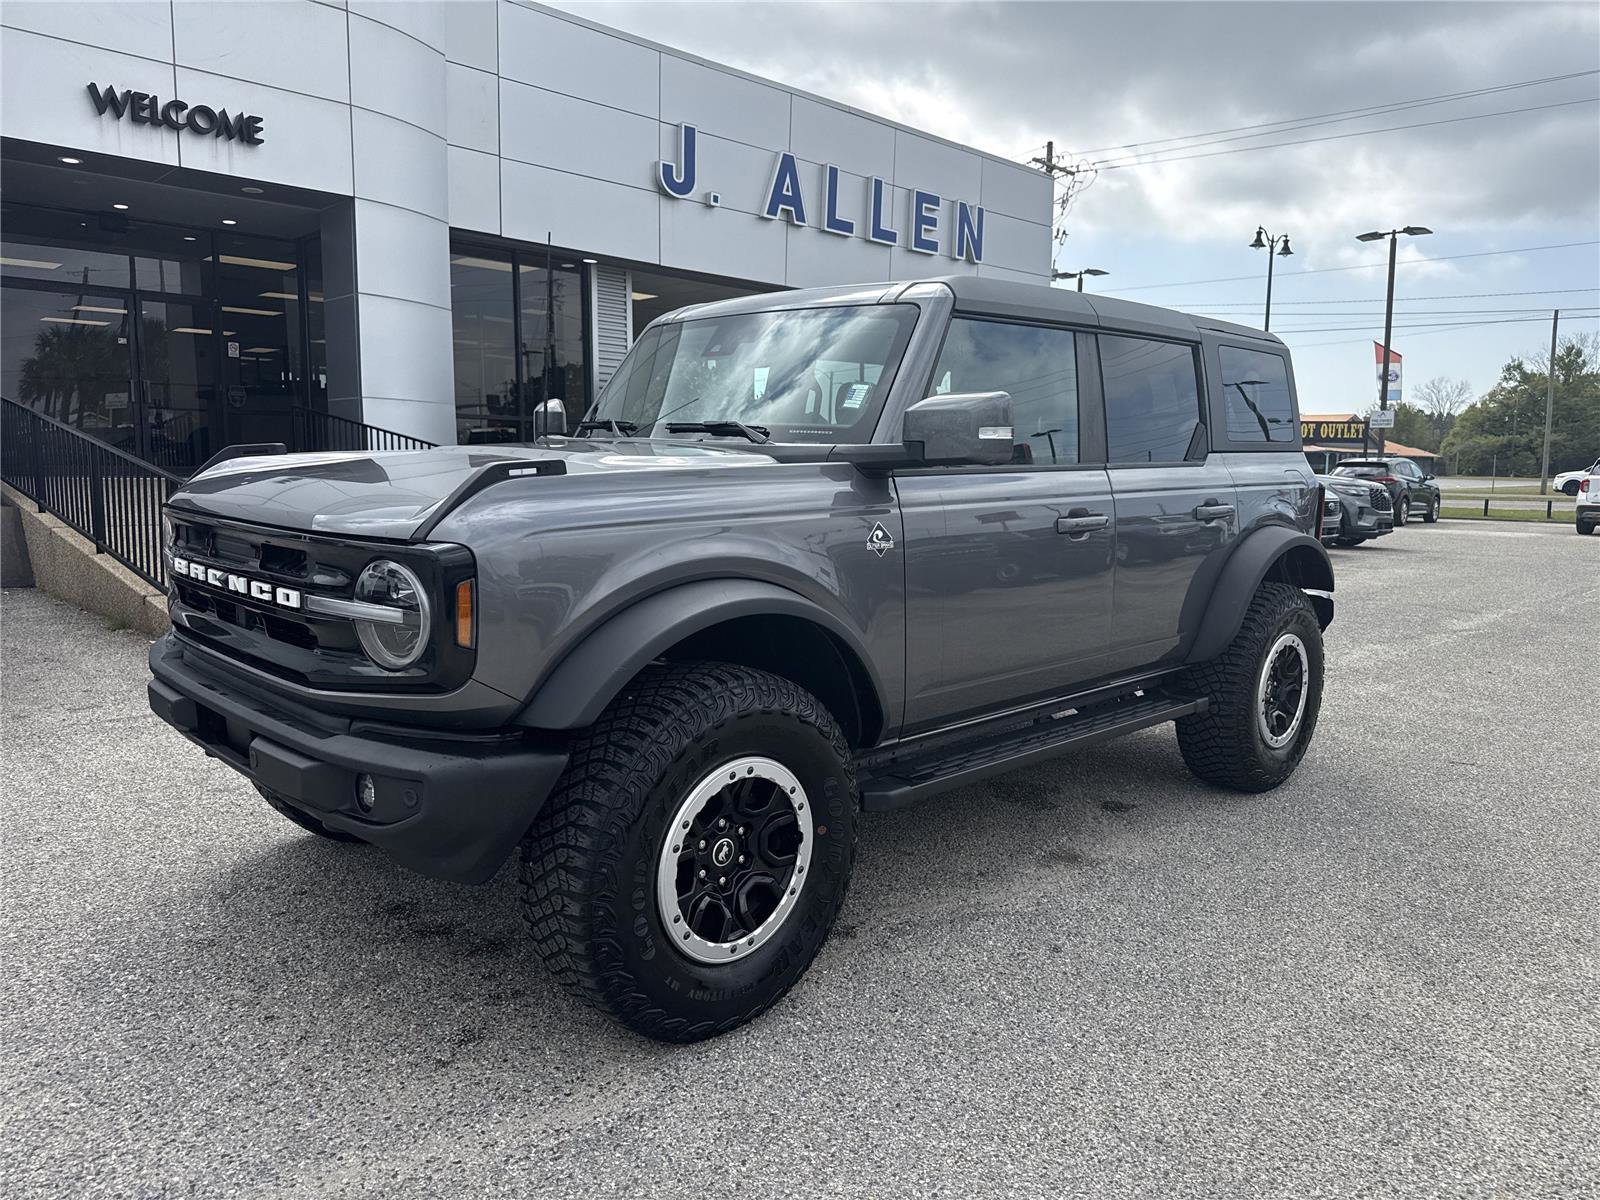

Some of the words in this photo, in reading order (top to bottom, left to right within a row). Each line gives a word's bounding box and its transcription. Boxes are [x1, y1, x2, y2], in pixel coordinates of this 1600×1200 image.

[87, 82, 264, 145] WELCOME
[655, 122, 721, 207] J.
[760, 151, 985, 263] ALLEN
[1320, 423, 1365, 438] OUTLET
[174, 557, 301, 608] BRONCO
